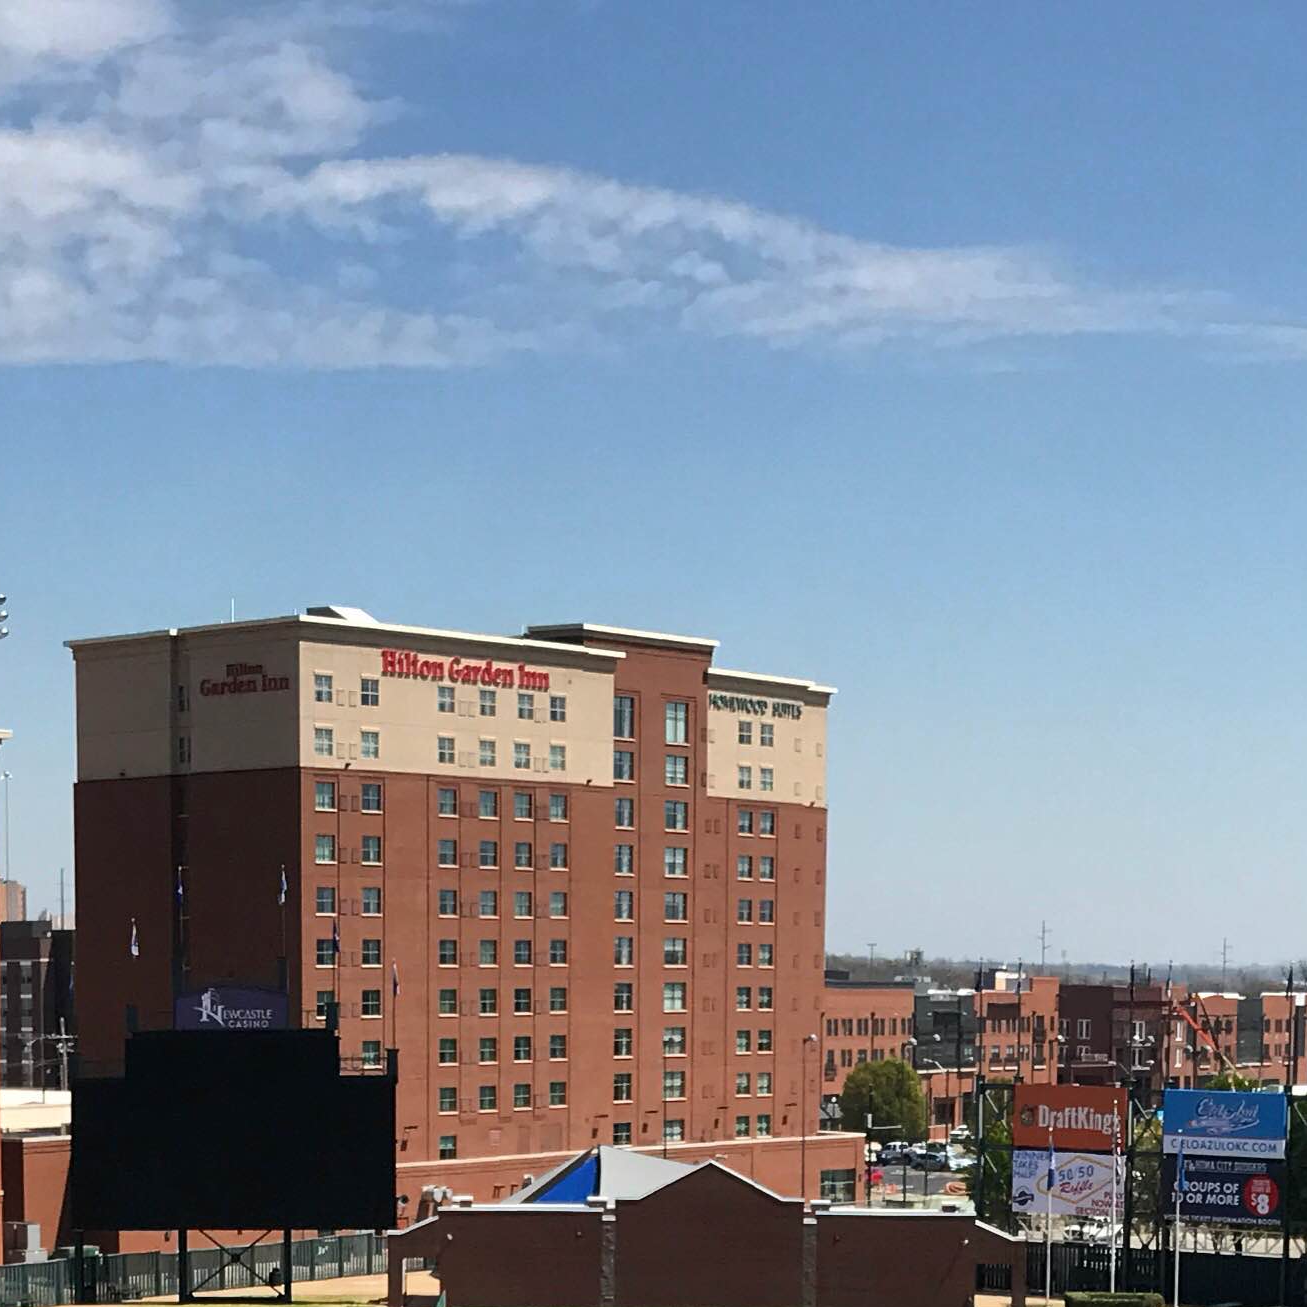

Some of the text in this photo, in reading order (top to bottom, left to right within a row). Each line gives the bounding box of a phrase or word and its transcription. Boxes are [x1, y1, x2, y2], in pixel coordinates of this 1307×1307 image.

[226, 663, 263, 677] Hilton
[381, 648, 551, 692] Hilton Garden Inn
[200, 674, 290, 697] Garden Inn
[228, 1020, 270, 1029] CASINO
[1171, 1139, 1277, 1154] CELOAZULOKC.COM
[1223, 1184, 1239, 1194] OF
[1186, 1193, 1203, 1204] OR
[1205, 1194, 1239, 1206] MORE
